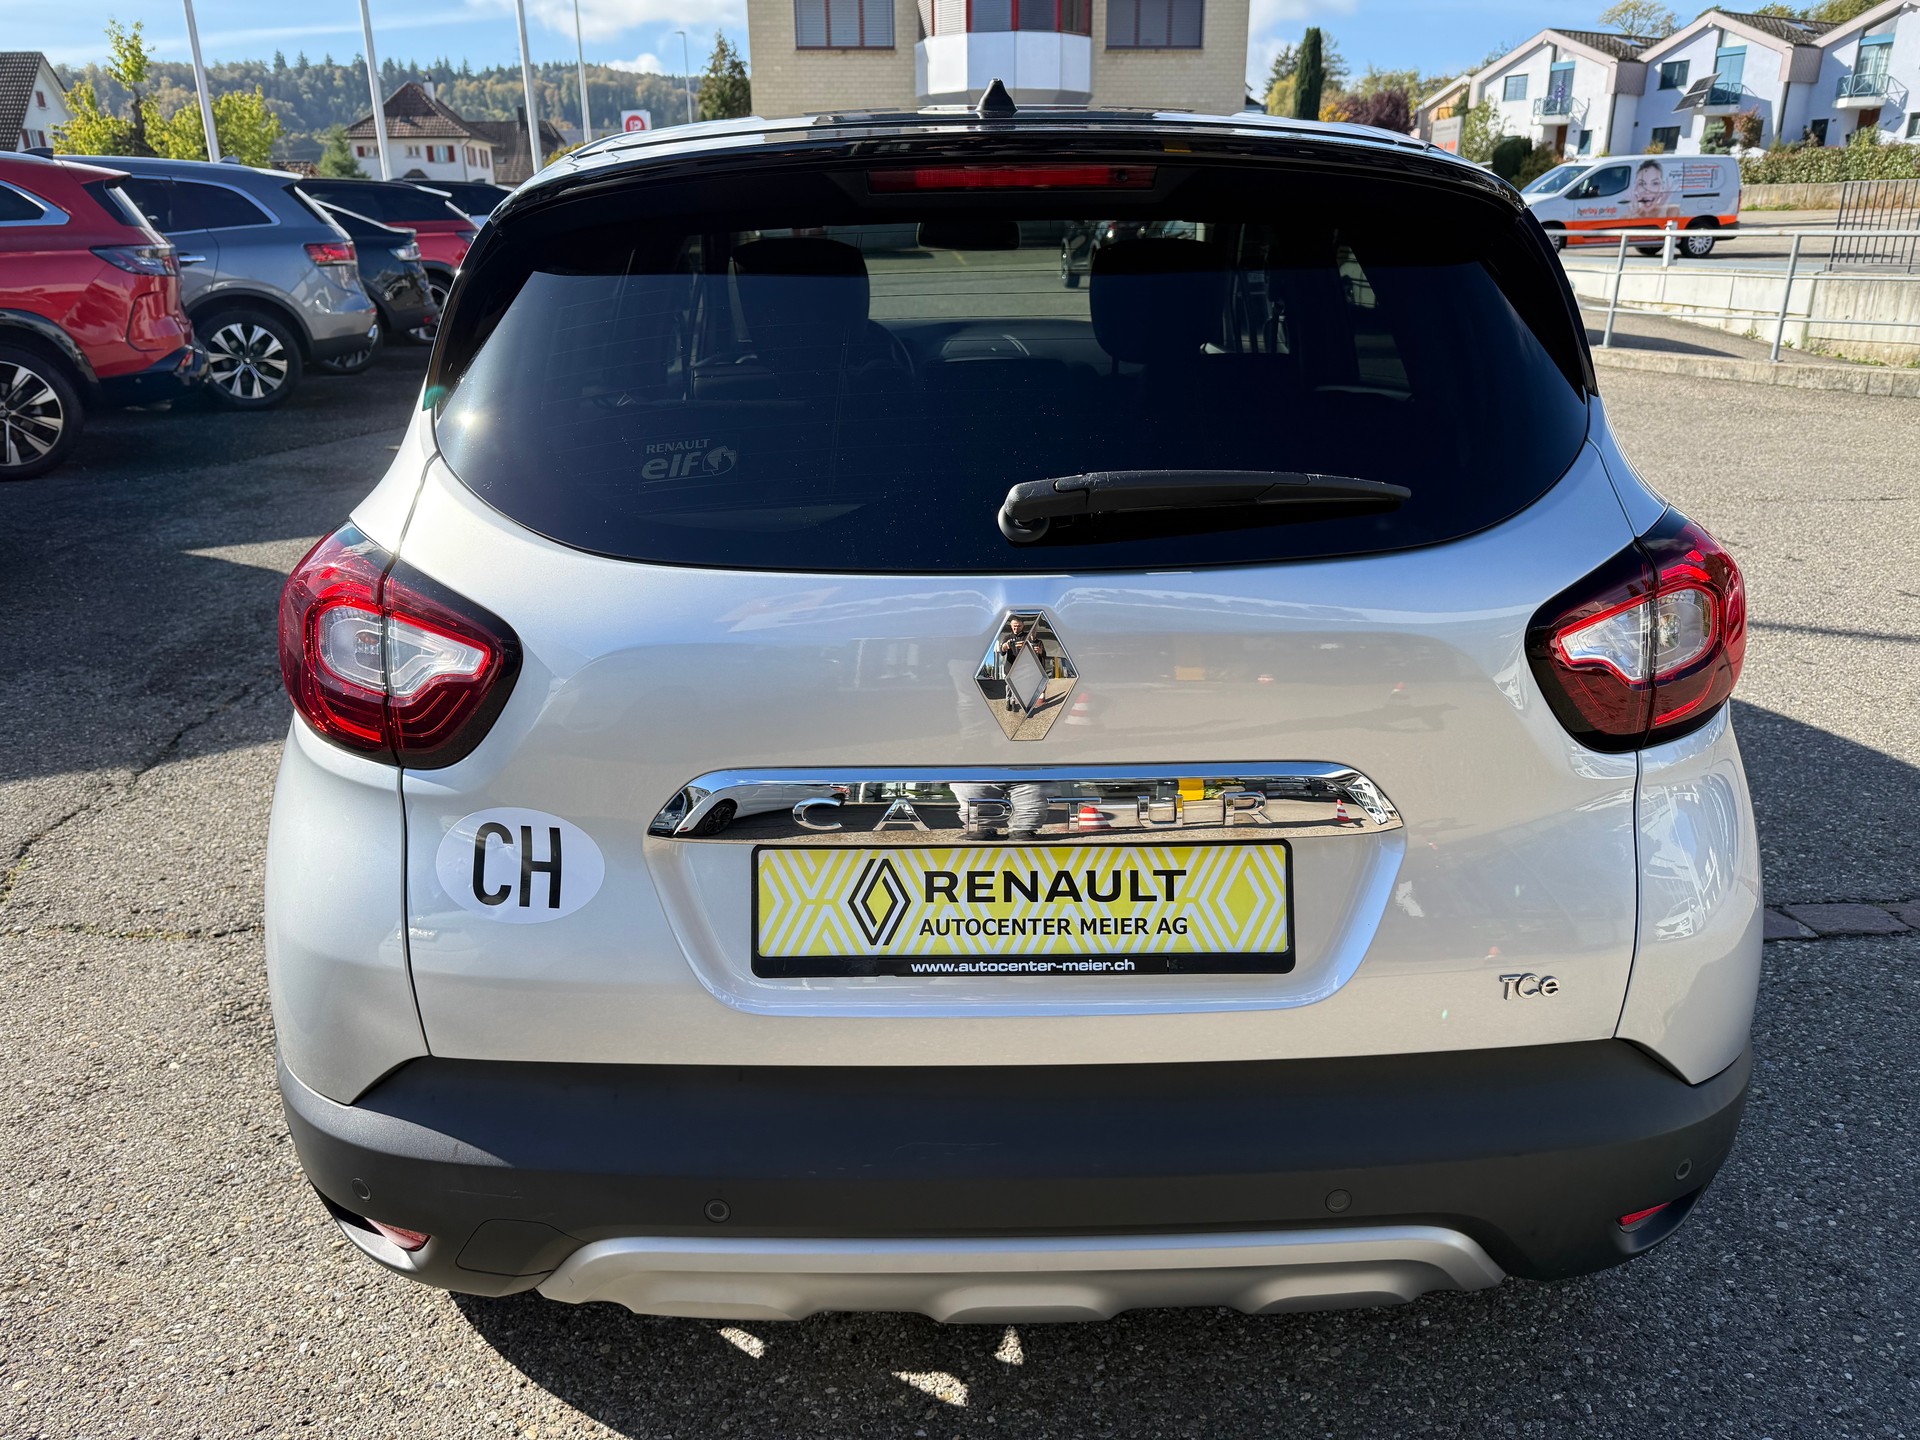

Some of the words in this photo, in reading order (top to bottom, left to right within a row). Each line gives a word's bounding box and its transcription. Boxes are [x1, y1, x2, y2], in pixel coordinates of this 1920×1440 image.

[646, 438, 711, 454] RENAULT
[641, 451, 702, 480] elf
[792, 791, 1273, 832] CAPTUR
[472, 822, 562, 909] CH
[924, 869, 1187, 903] RENAULT
[919, 918, 1072, 936] AUTOCENTER
[1080, 917, 1149, 935] MEIER
[1156, 917, 1188, 935] AG
[910, 959, 1135, 973] www.autocenter-meier.ch
[1499, 972, 1560, 1000] TCe
